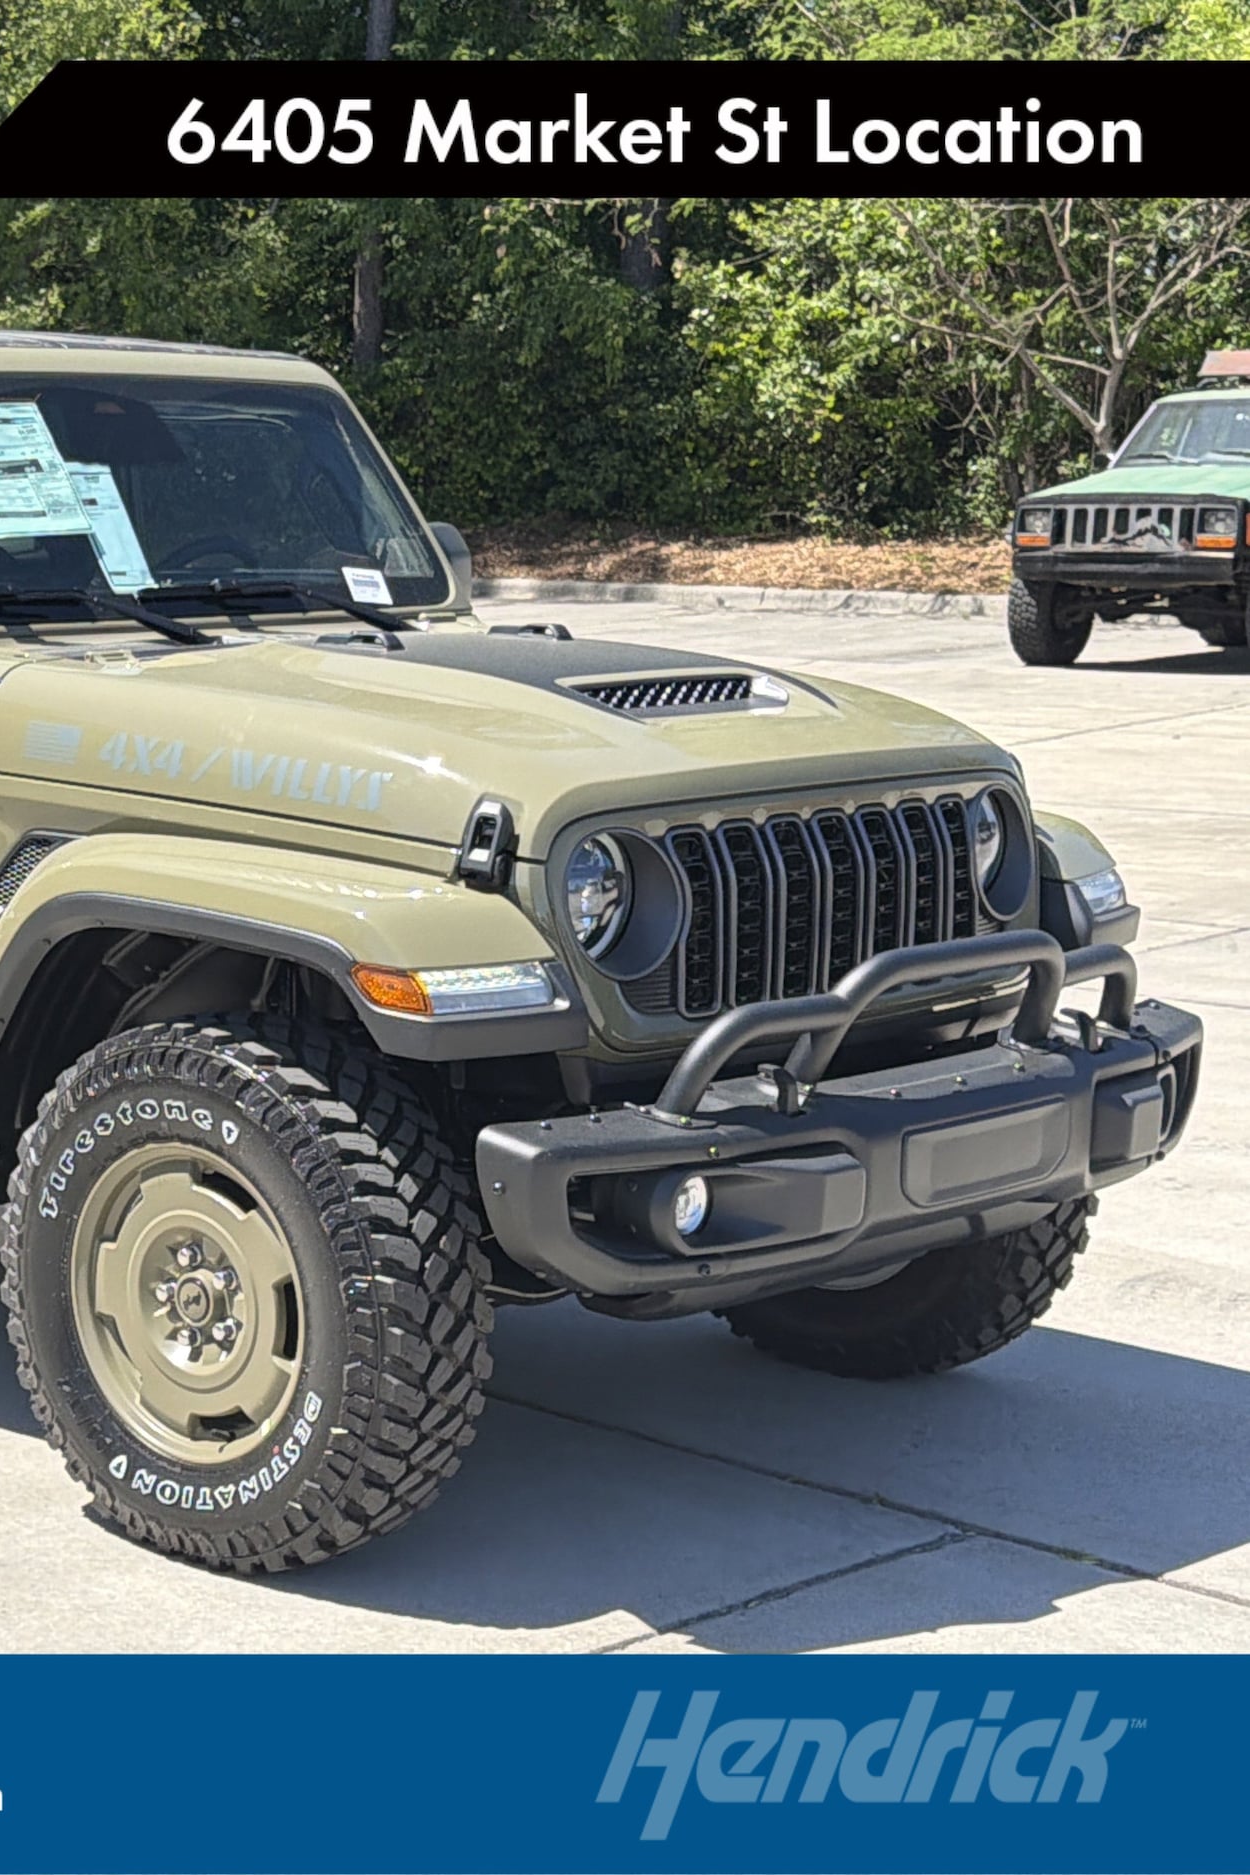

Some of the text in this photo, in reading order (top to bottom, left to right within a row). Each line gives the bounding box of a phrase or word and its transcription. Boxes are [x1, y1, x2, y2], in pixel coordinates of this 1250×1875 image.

[230, 749, 394, 813] WILLYS
[39, 1099, 214, 1219] Firestone
[131, 1391, 323, 1511] DESTINATION
